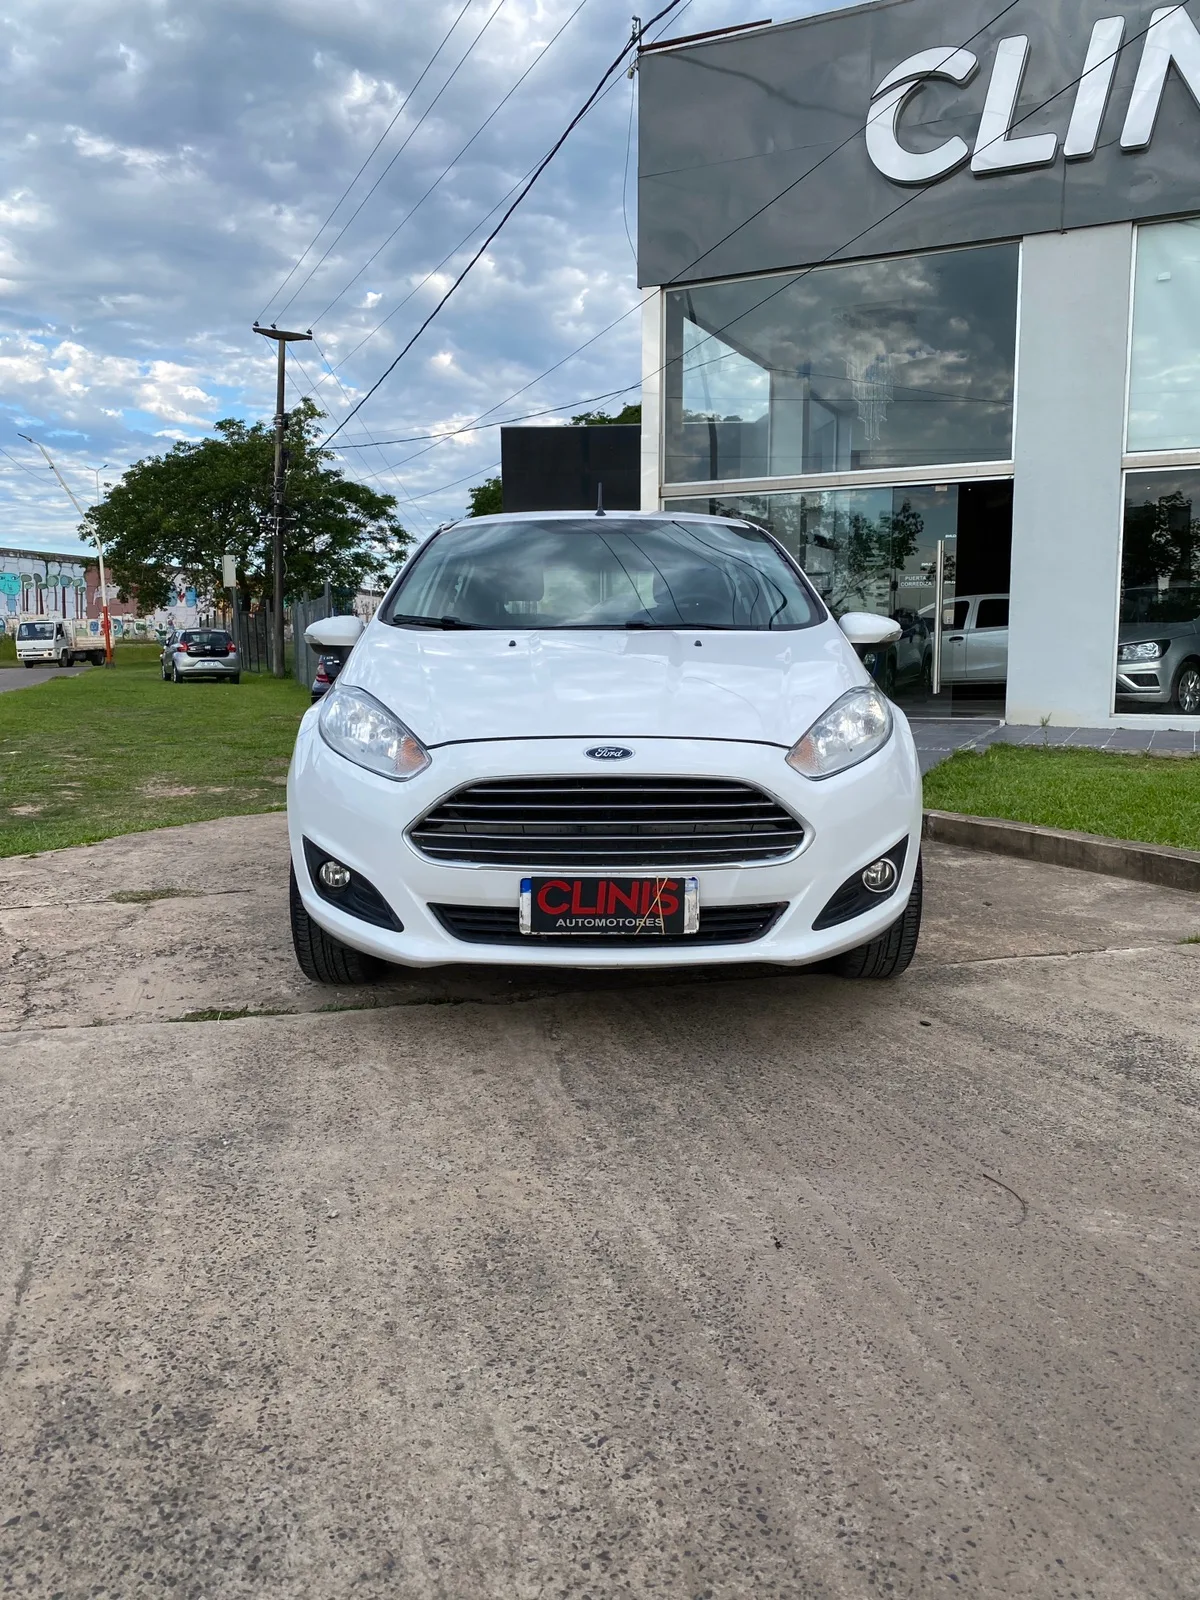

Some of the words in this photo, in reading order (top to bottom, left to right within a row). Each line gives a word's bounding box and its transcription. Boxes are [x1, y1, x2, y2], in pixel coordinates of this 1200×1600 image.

[595, 746, 624, 757] Ford
[536, 880, 679, 916] CLINIS
[556, 918, 664, 928] AUTOMOTORES
